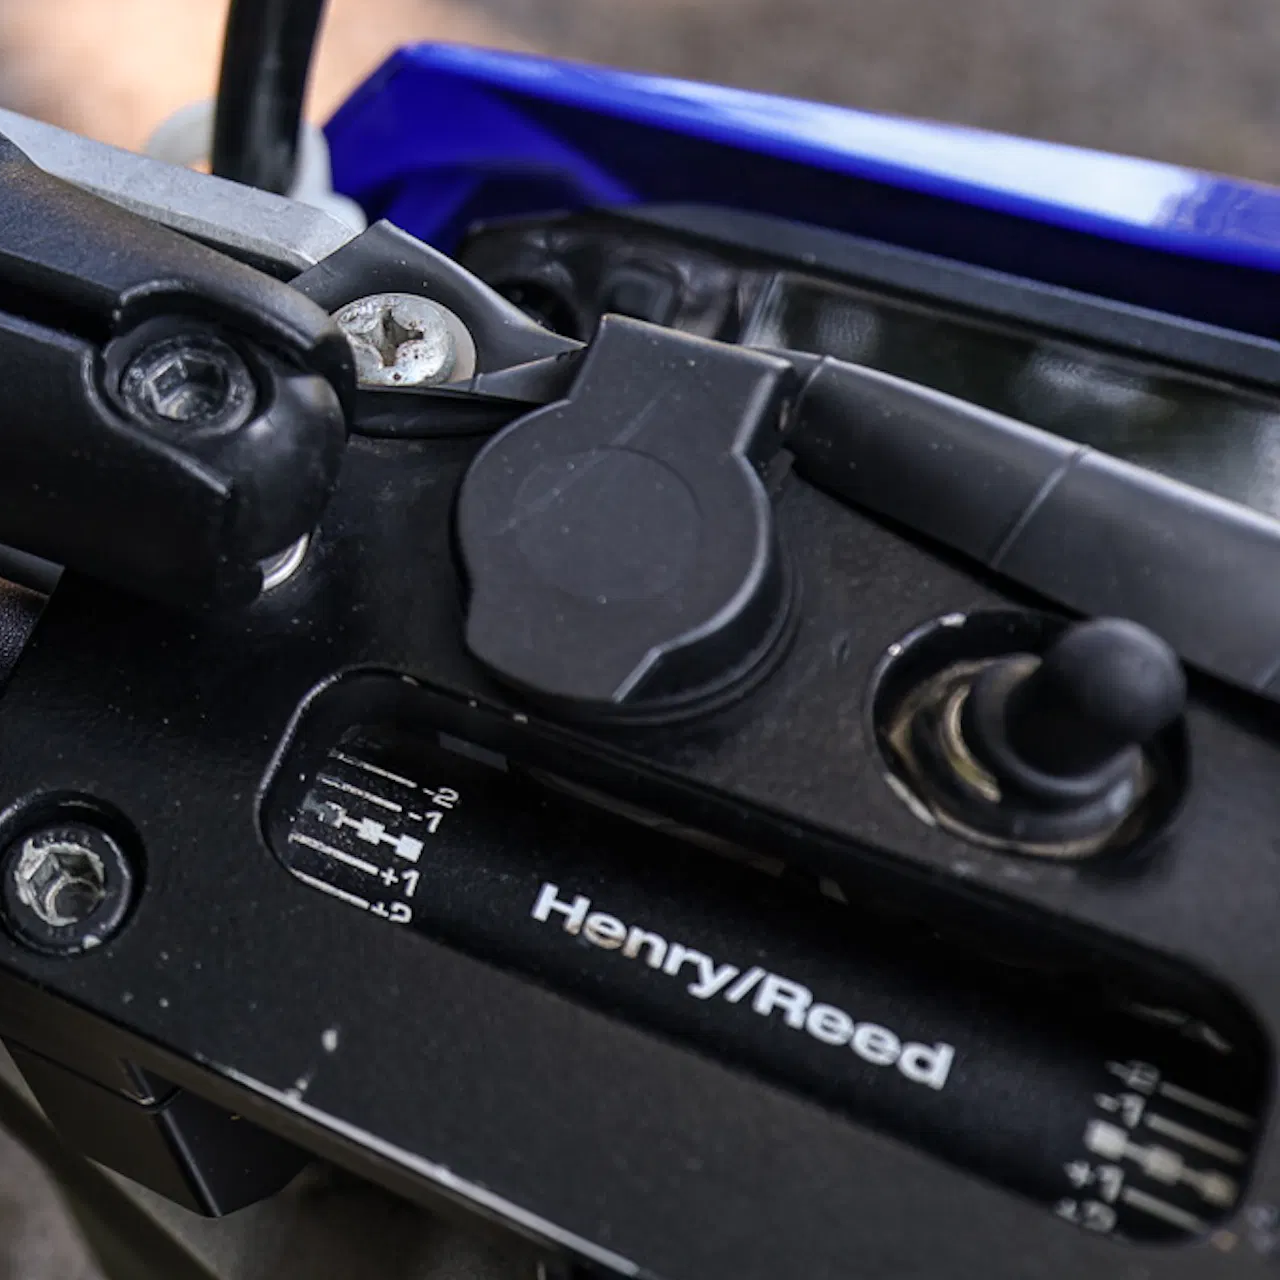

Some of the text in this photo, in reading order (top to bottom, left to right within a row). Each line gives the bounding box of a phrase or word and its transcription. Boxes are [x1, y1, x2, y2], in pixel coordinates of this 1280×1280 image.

[422, 786, 459, 809] -2
[407, 810, 444, 834] -1
[379, 867, 421, 898] +1
[531, 882, 956, 1091] Henry/Reed
